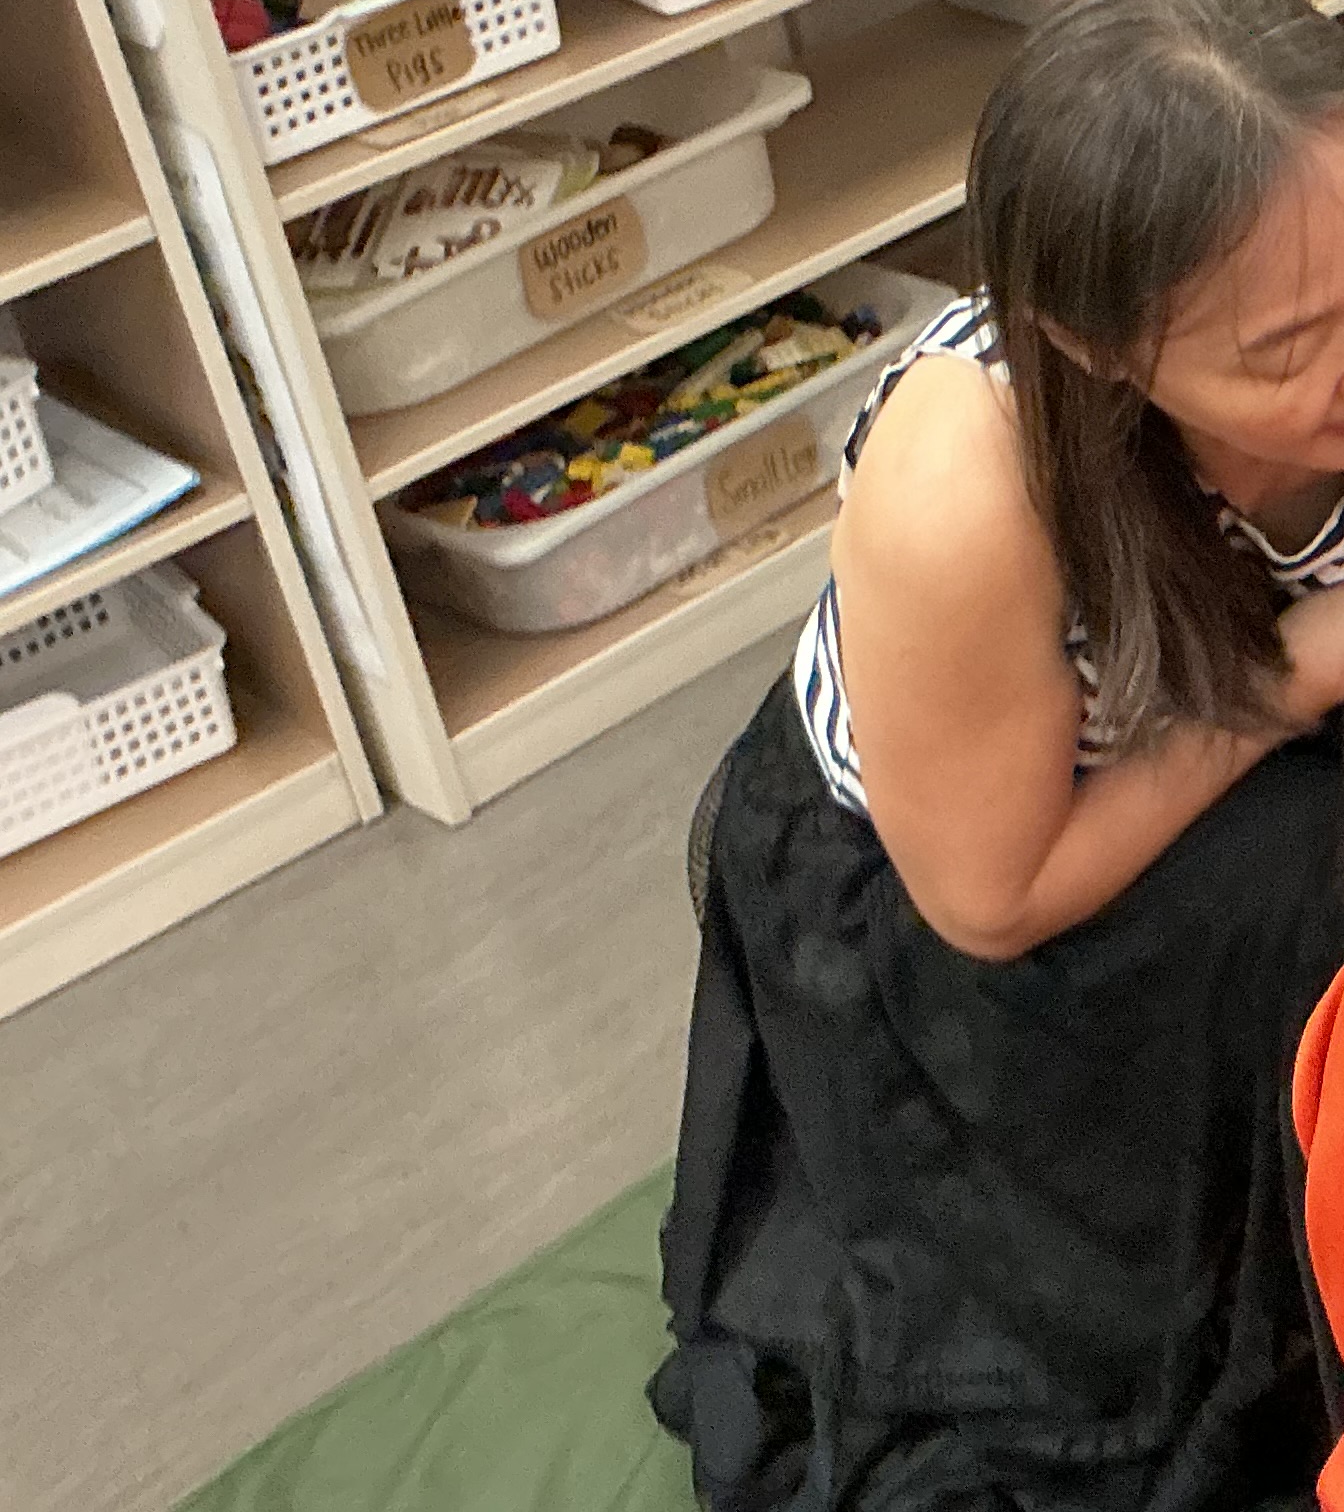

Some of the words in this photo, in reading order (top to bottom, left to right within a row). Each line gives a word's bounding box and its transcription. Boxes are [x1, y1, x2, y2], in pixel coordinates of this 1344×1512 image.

[353, 19, 409, 58] Three
[386, 48, 444, 92] Pigs
[533, 213, 618, 273] Wooden
[549, 247, 620, 305] Sticks
